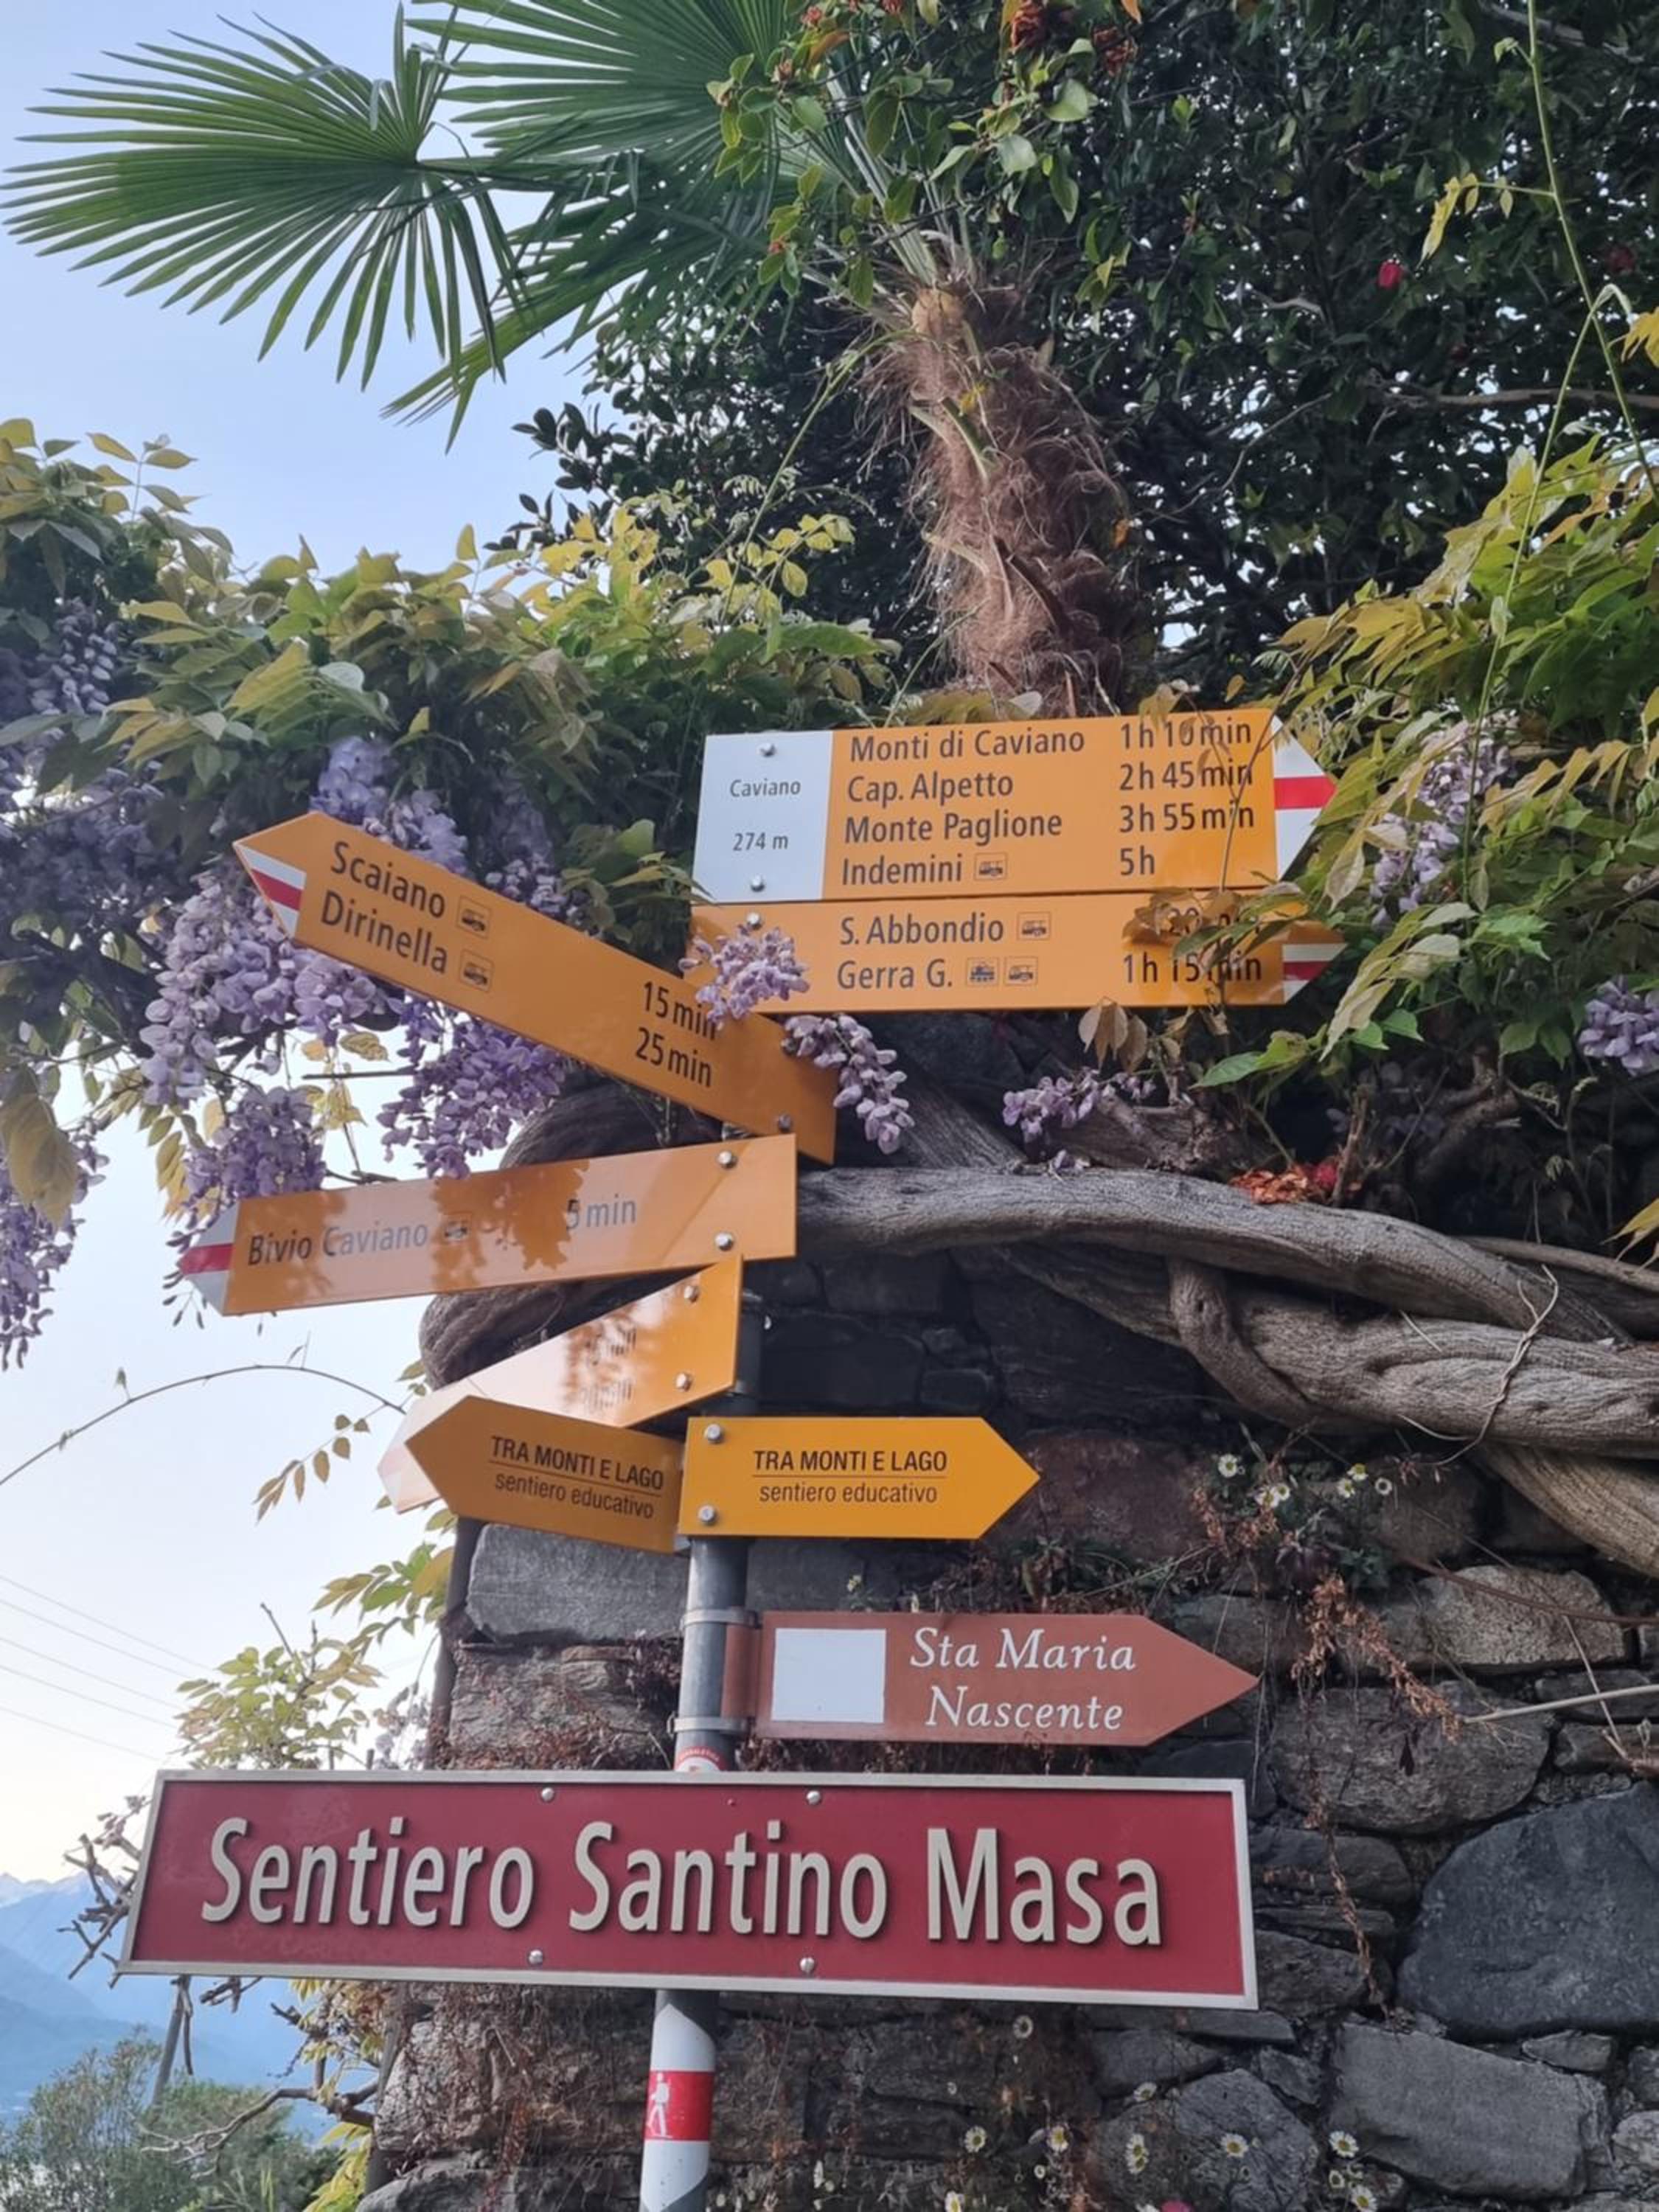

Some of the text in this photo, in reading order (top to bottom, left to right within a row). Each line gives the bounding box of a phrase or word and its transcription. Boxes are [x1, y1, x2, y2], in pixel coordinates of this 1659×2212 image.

[850, 732, 929, 762] Monti
[939, 729, 964, 759] di
[974, 726, 1085, 757] Caviano
[730, 778, 801, 799] Caviano
[848, 776, 904, 808] Cap.
[911, 771, 1014, 807] Alpetto
[732, 832, 789, 852] 274 m
[844, 815, 933, 845] Monte
[943, 810, 1062, 846] Paglione
[331, 841, 446, 919] Scaiano
[842, 853, 963, 886] Indemini
[320, 891, 450, 975] Dirinella
[840, 911, 1004, 946] S. Abbondio
[838, 960, 914, 990] Gerra
[927, 959, 953, 988] G.
[248, 1229, 313, 1267] Bivio
[321, 1221, 429, 1258] Caviano
[491, 1435, 664, 1491] TRA MONTI E LAGO
[754, 1450, 948, 1472] TRA MONTI E LAGO
[495, 1472, 654, 1520] sentiero educativo
[759, 1481, 937, 1503] sentiero educativo
[909, 1627, 1137, 1672] Sta Maria
[925, 1685, 1124, 1731] Nascente
[201, 1815, 1162, 1947] Sentiero Santino Masa
